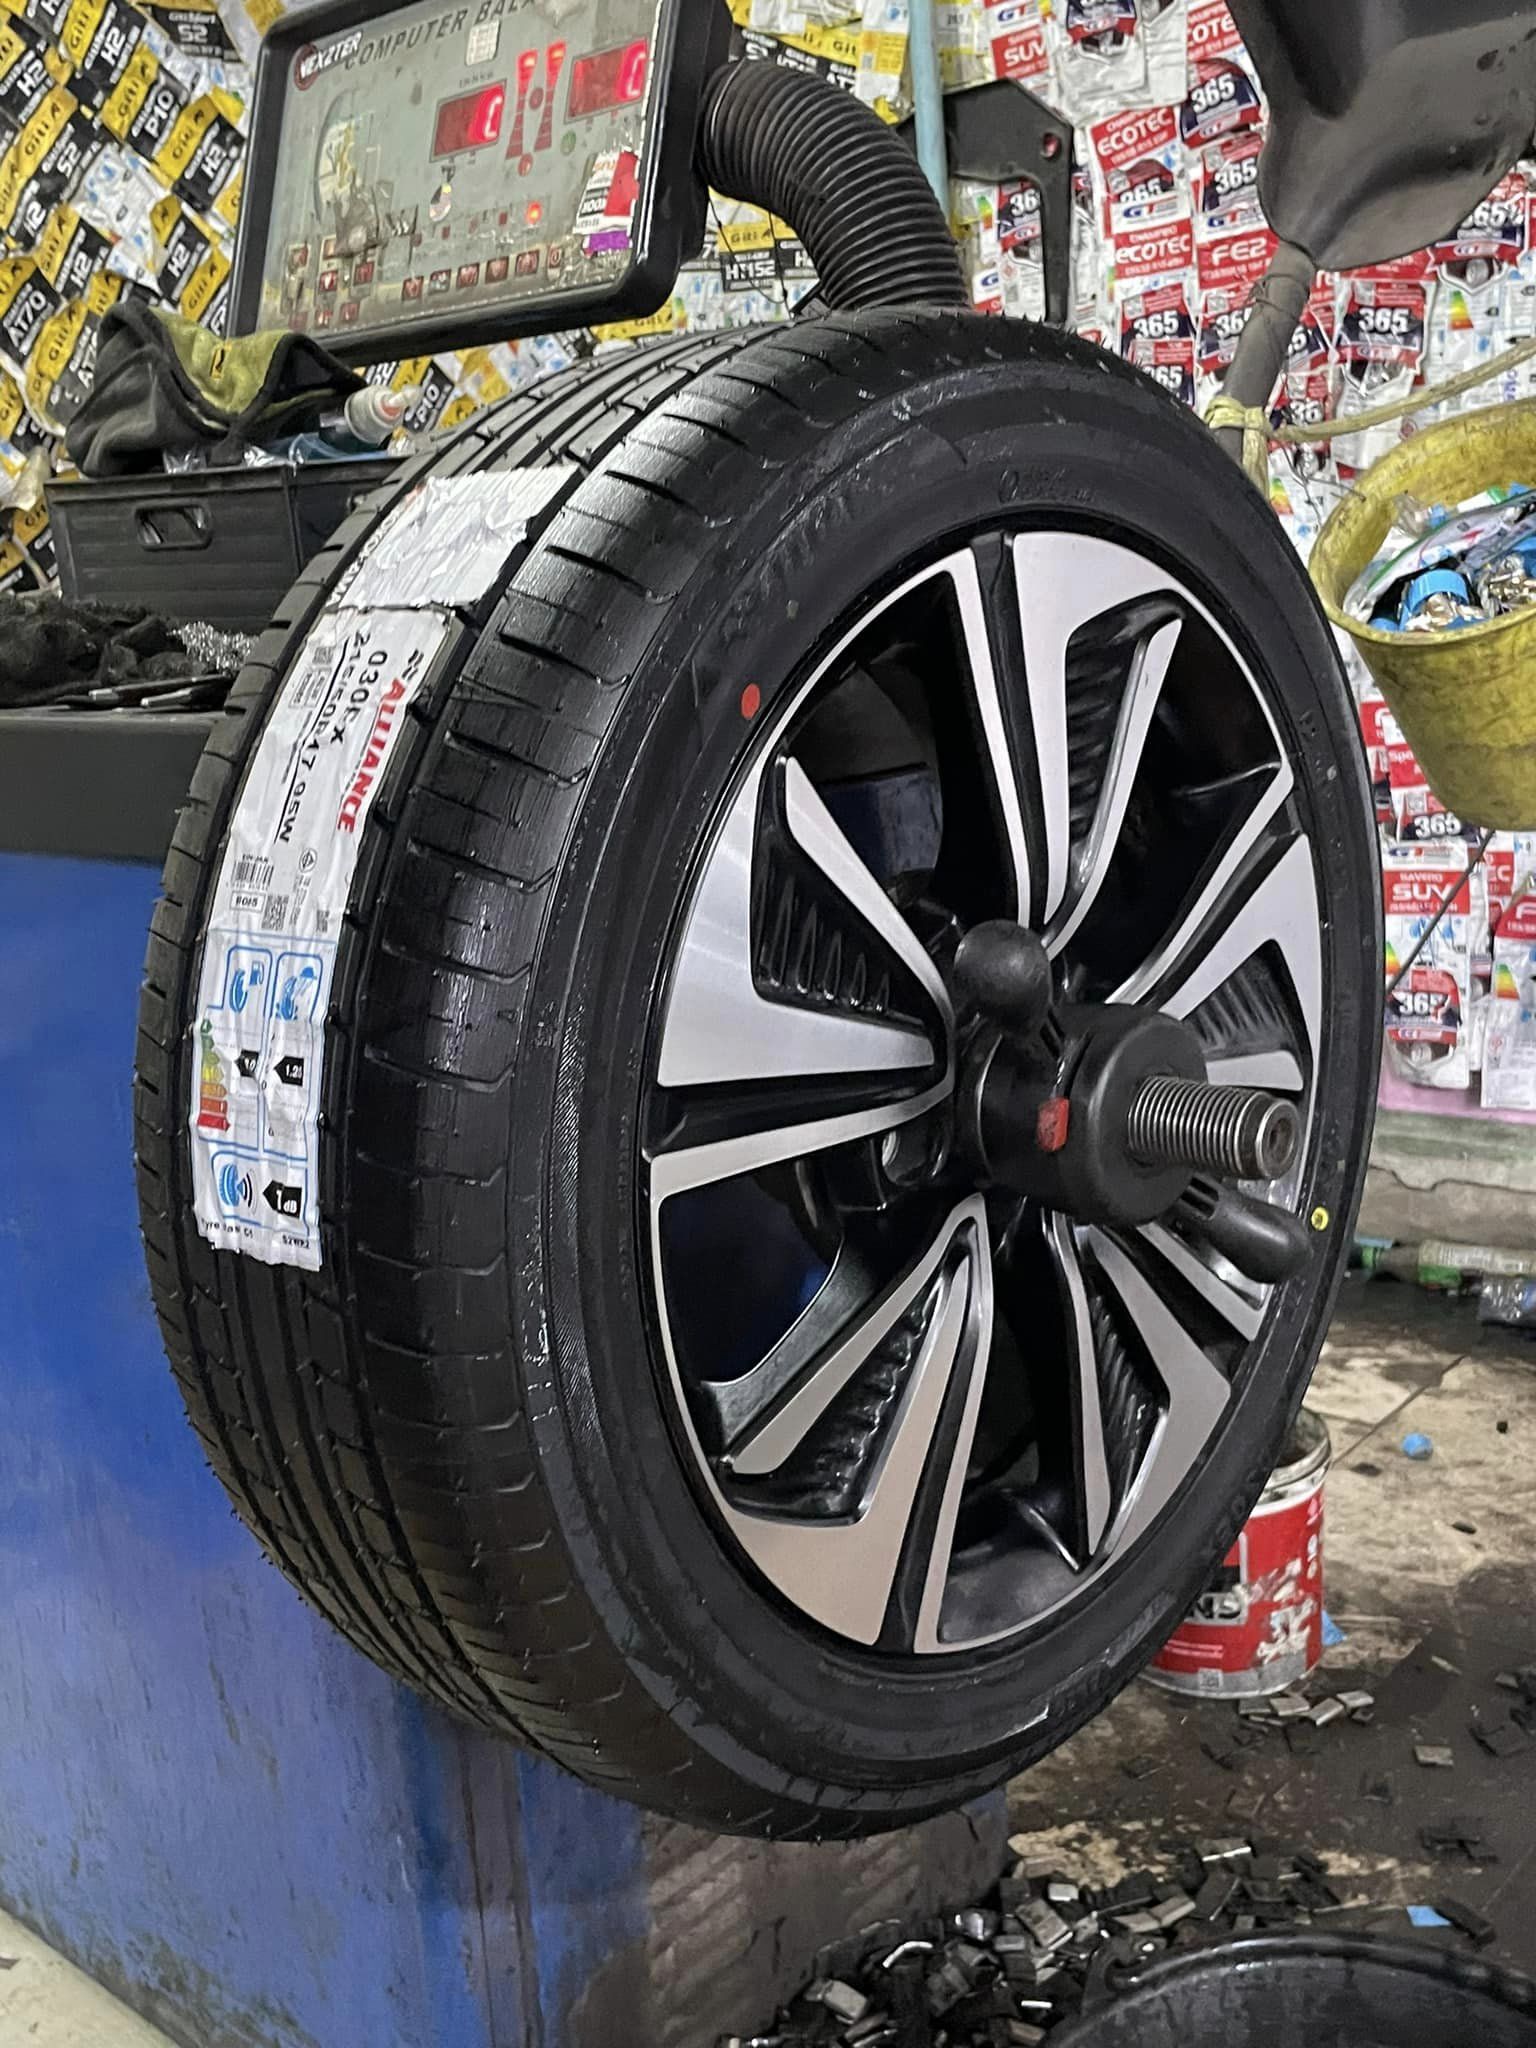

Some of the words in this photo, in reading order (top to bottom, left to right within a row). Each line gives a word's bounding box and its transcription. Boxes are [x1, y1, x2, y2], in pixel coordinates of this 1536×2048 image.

[70, 11, 90, 49] Giti
[101, 26, 126, 66] H2
[178, 24, 208, 43] S2
[16, 58, 48, 97] H2
[1191, 73, 1236, 114] 365
[117, 81, 141, 117] Giti
[145, 90, 174, 138] P10
[24, 121, 50, 156] Giti
[57, 142, 82, 178] S2
[201, 143, 227, 179] H2
[1214, 158, 1258, 195] 365
[1124, 203, 1154, 218] GT
[1208, 210, 1237, 228] GT
[731, 229, 758, 244] Giti
[167, 242, 191, 279] H2
[189, 277, 209, 310] Giti
[7, 290, 46, 348] AT70
[1133, 310, 1179, 339] 365
[1358, 307, 1409, 334] 365
[48, 327, 69, 361] Giti
[415, 383, 440, 423] P10
[337, 678, 406, 834] ALLIANCE
[278, 783, 307, 843] 95W
[1392, 882, 1453, 902] SUV
